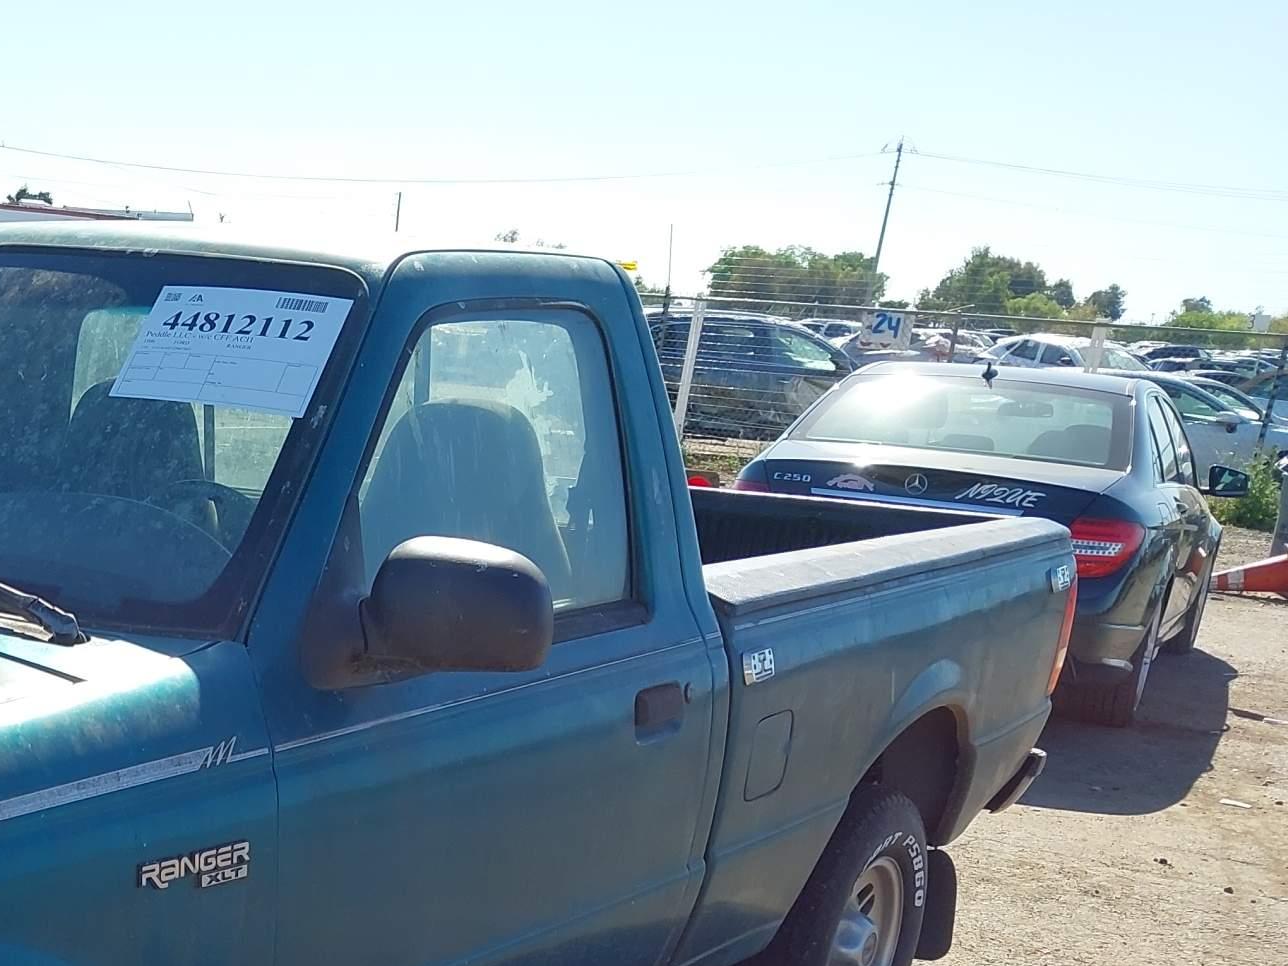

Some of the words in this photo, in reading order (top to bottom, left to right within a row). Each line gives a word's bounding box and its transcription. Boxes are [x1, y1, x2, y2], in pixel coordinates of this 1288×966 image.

[162, 310, 315, 342] 44812112
[872, 312, 901, 339] 24
[140, 841, 251, 889] RANGER
[207, 866, 244, 886] XLT
